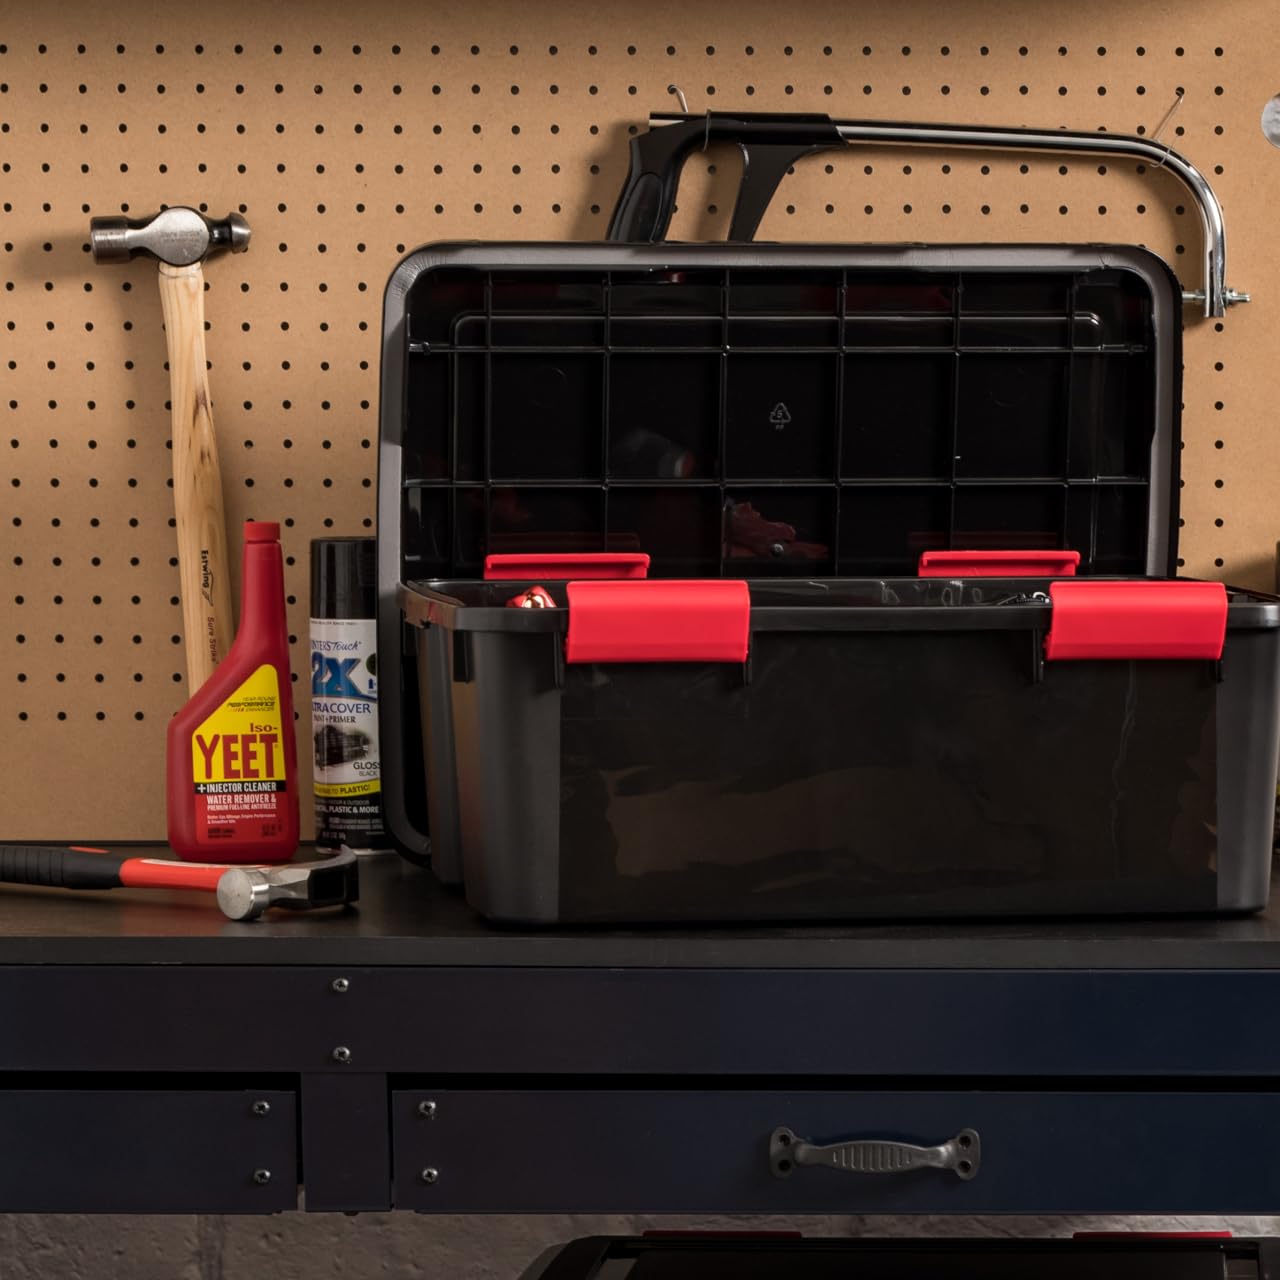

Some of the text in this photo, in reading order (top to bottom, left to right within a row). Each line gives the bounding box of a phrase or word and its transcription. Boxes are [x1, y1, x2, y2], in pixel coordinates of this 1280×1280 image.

[200, 549, 210, 588] Estwing
[207, 616, 216, 637] Sure
[331, 640, 359, 652] Touch
[311, 651, 362, 695] 2X
[330, 703, 372, 714] COVER
[196, 733, 278, 780] YEET
[243, 782, 277, 792] CLEANER
[207, 794, 277, 805] WATER REMOVER &
[360, 806, 379, 814] MORE
